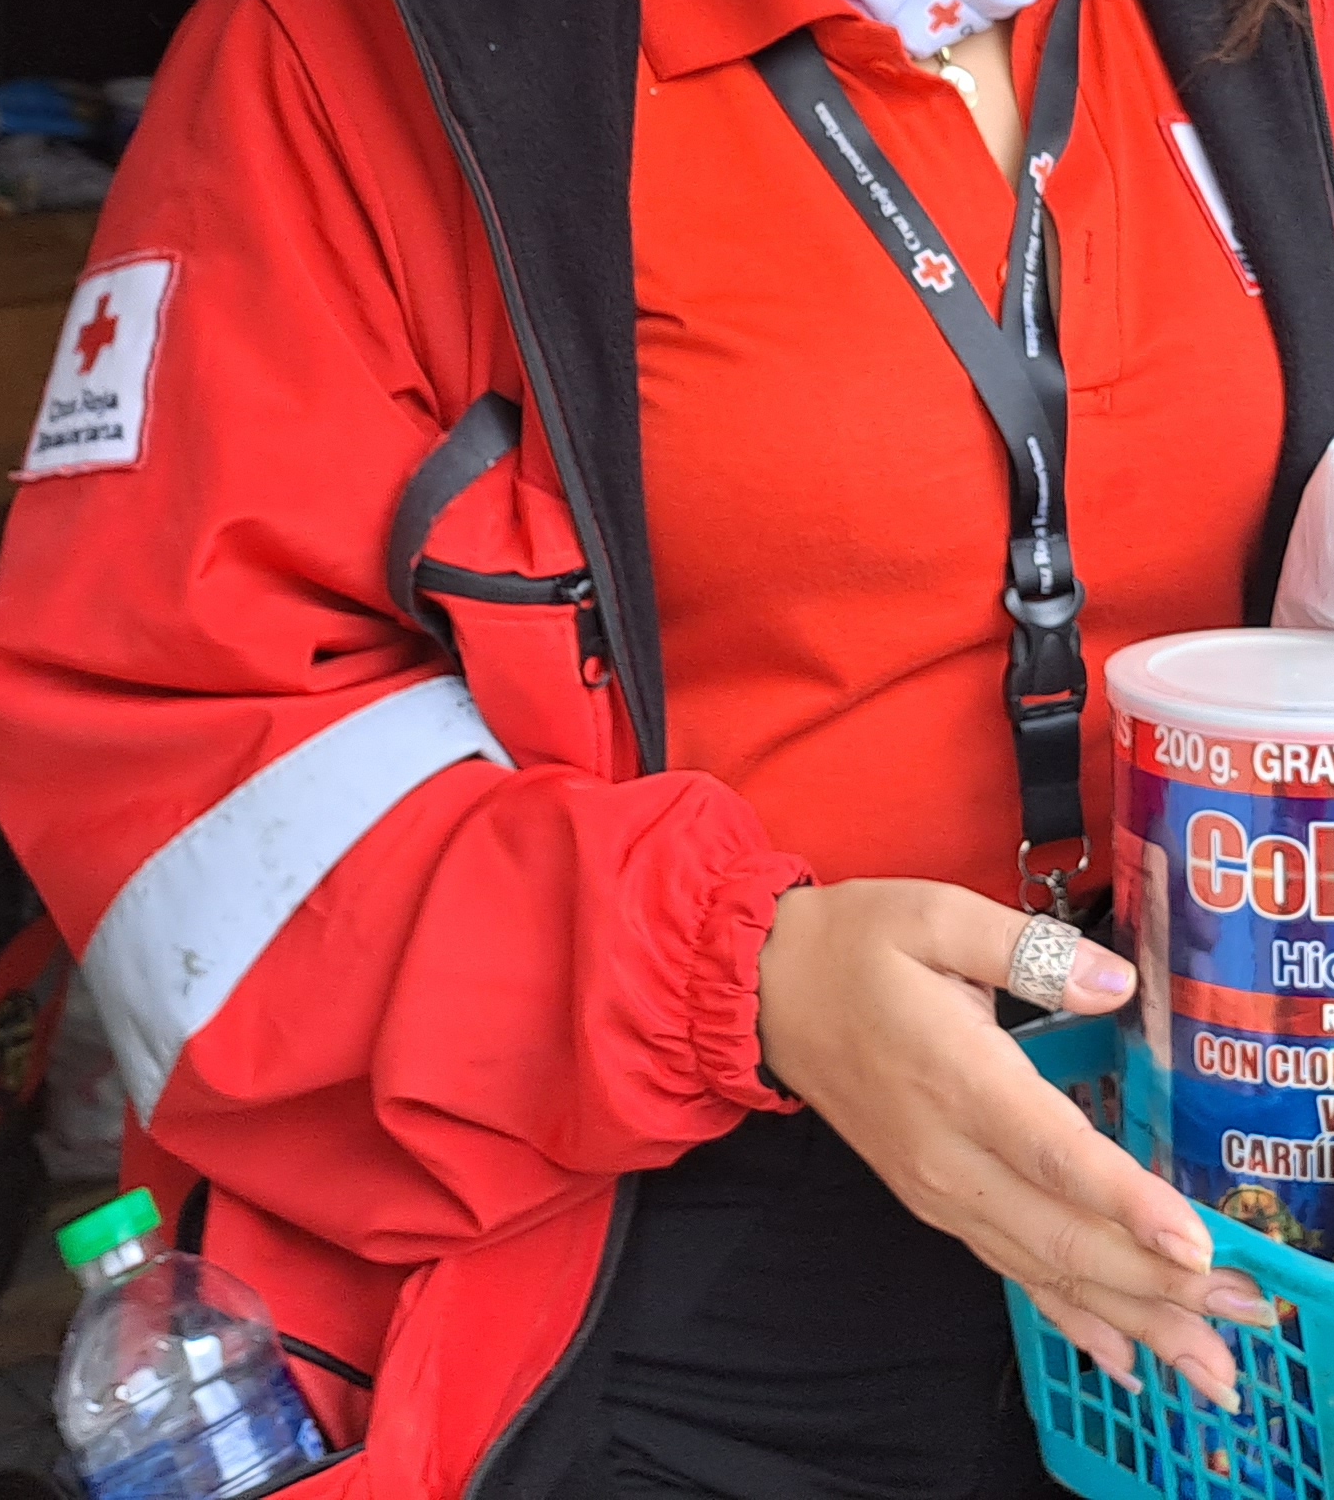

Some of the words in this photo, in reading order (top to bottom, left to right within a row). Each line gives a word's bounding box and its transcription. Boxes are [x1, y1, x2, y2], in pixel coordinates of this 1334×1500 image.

[1154, 723, 1205, 772] 200
[1208, 744, 1240, 785] g.
[1194, 1032, 1263, 1084] CON
